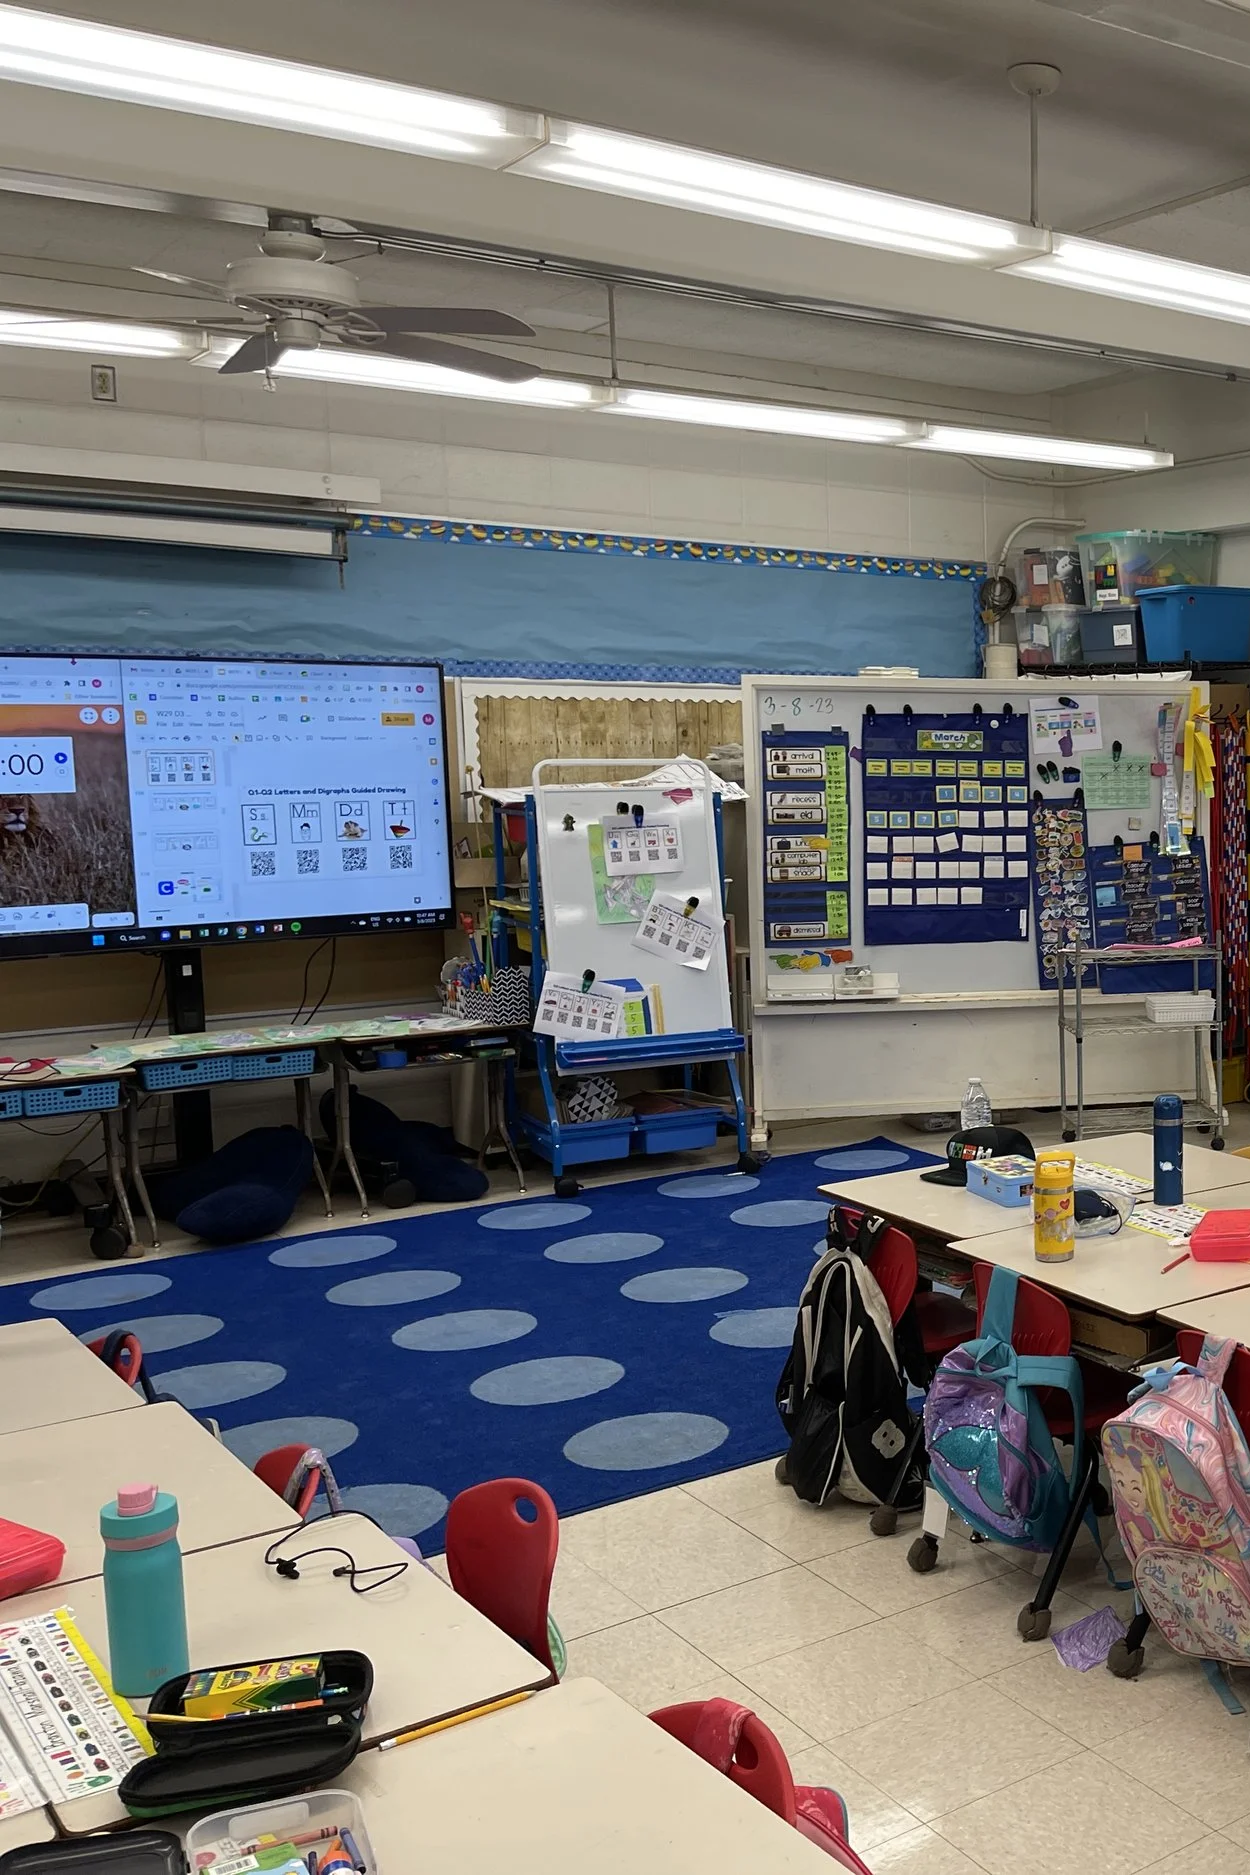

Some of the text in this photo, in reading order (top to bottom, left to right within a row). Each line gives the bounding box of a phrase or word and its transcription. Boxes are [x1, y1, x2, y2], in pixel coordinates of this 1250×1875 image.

[934, 733, 966, 742] March
[318, 787, 350, 795] Digraphs
[352, 786, 376, 794] Guided
[378, 786, 406, 794] Drawing
[793, 925, 821, 933] dismissal
[631, 1014, 636, 1022] 5
